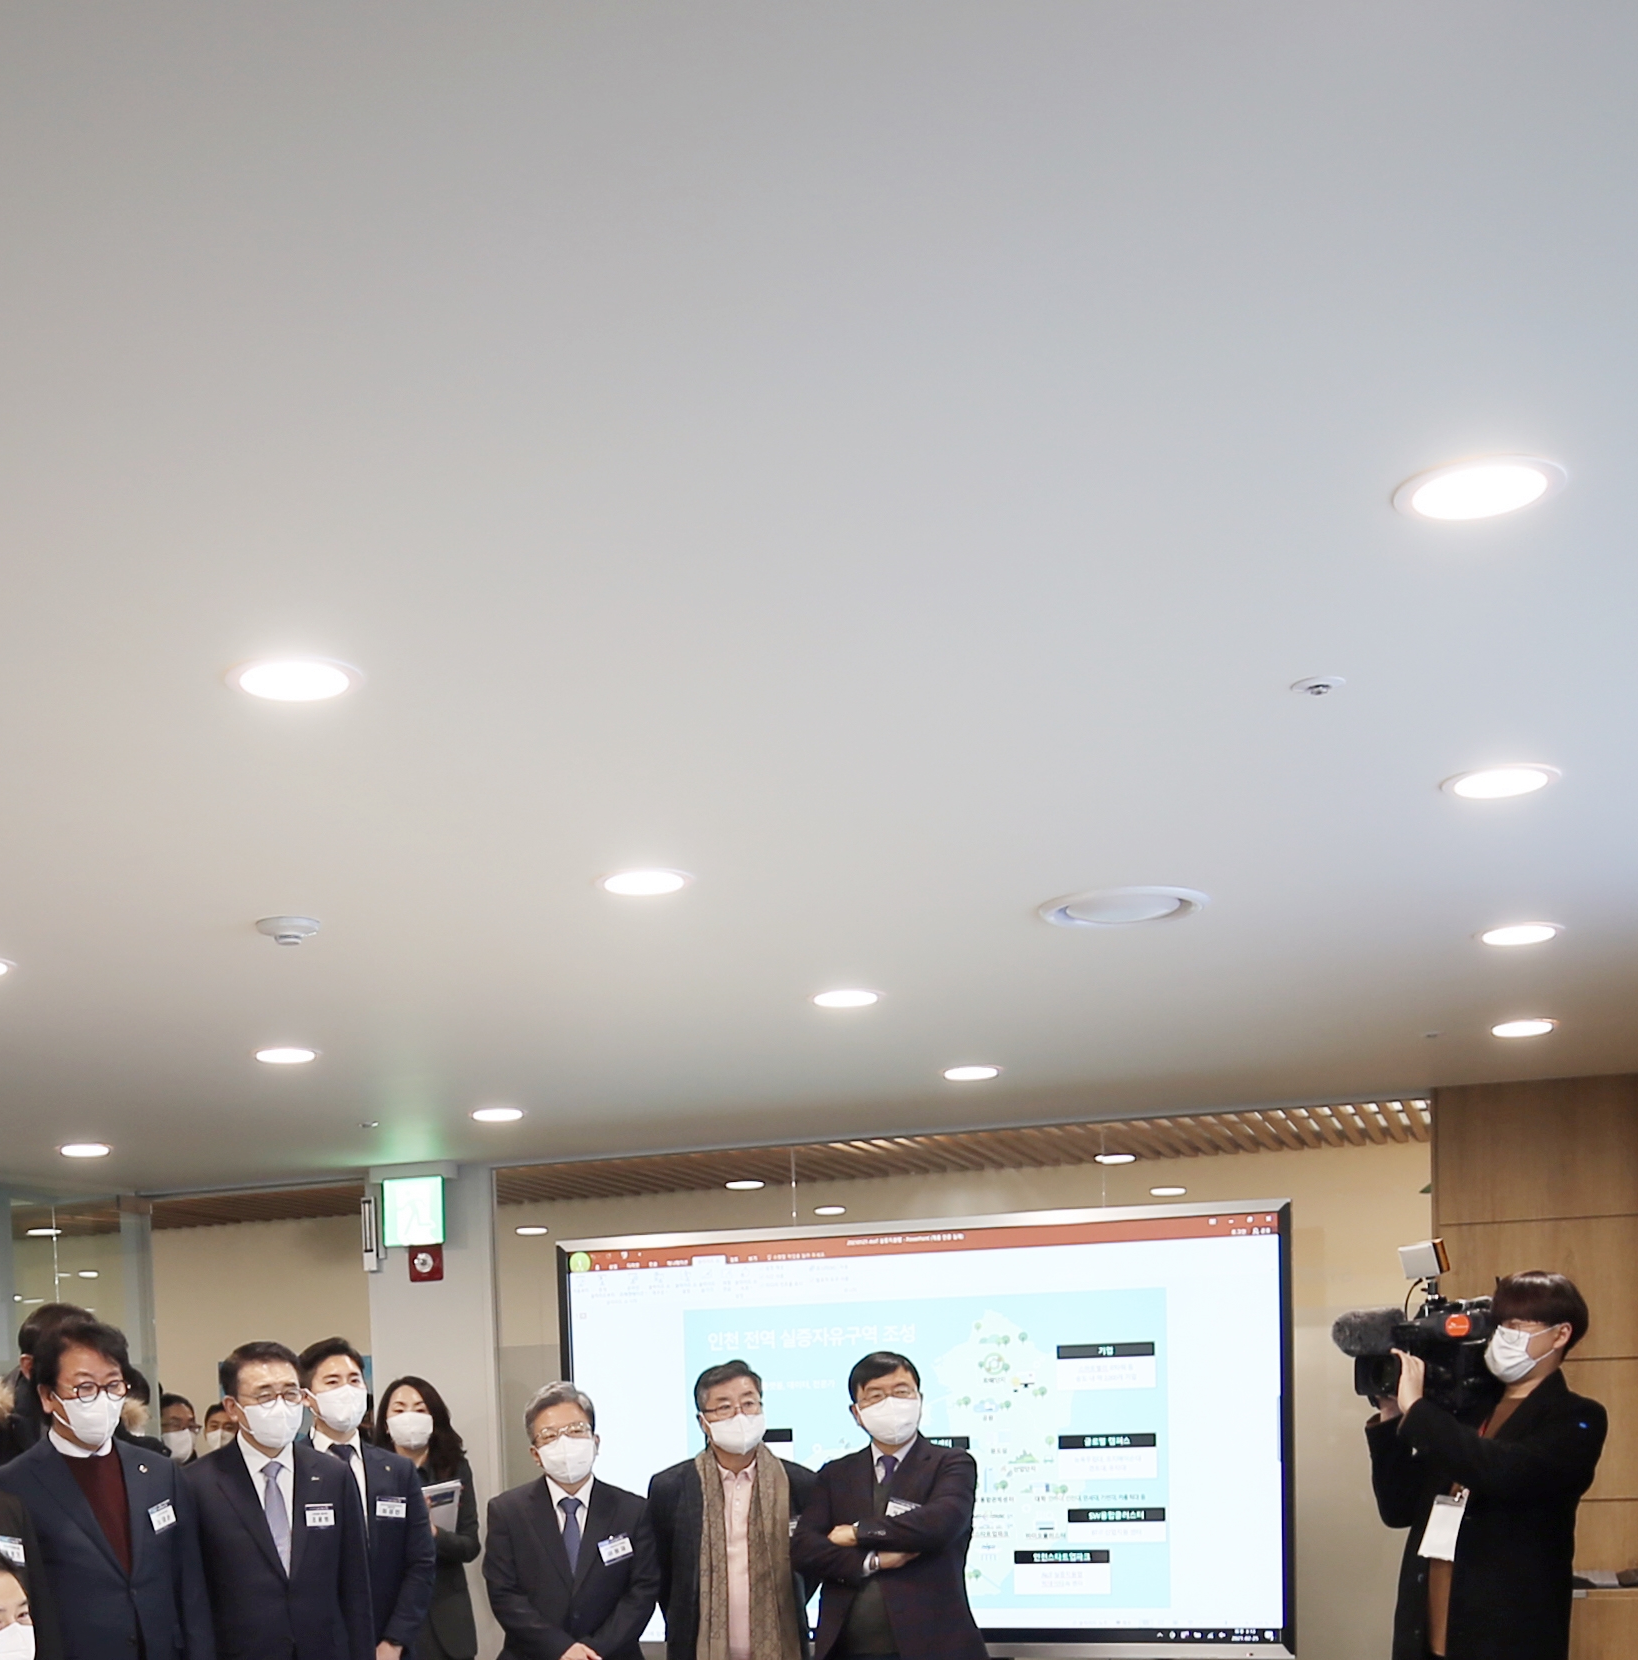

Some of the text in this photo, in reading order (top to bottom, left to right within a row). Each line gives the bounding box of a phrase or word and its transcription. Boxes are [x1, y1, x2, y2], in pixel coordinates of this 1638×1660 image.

[707, 1324, 916, 1352] 인천 전역 실증자유구역 조성
[1097, 1345, 1114, 1356] 기업
